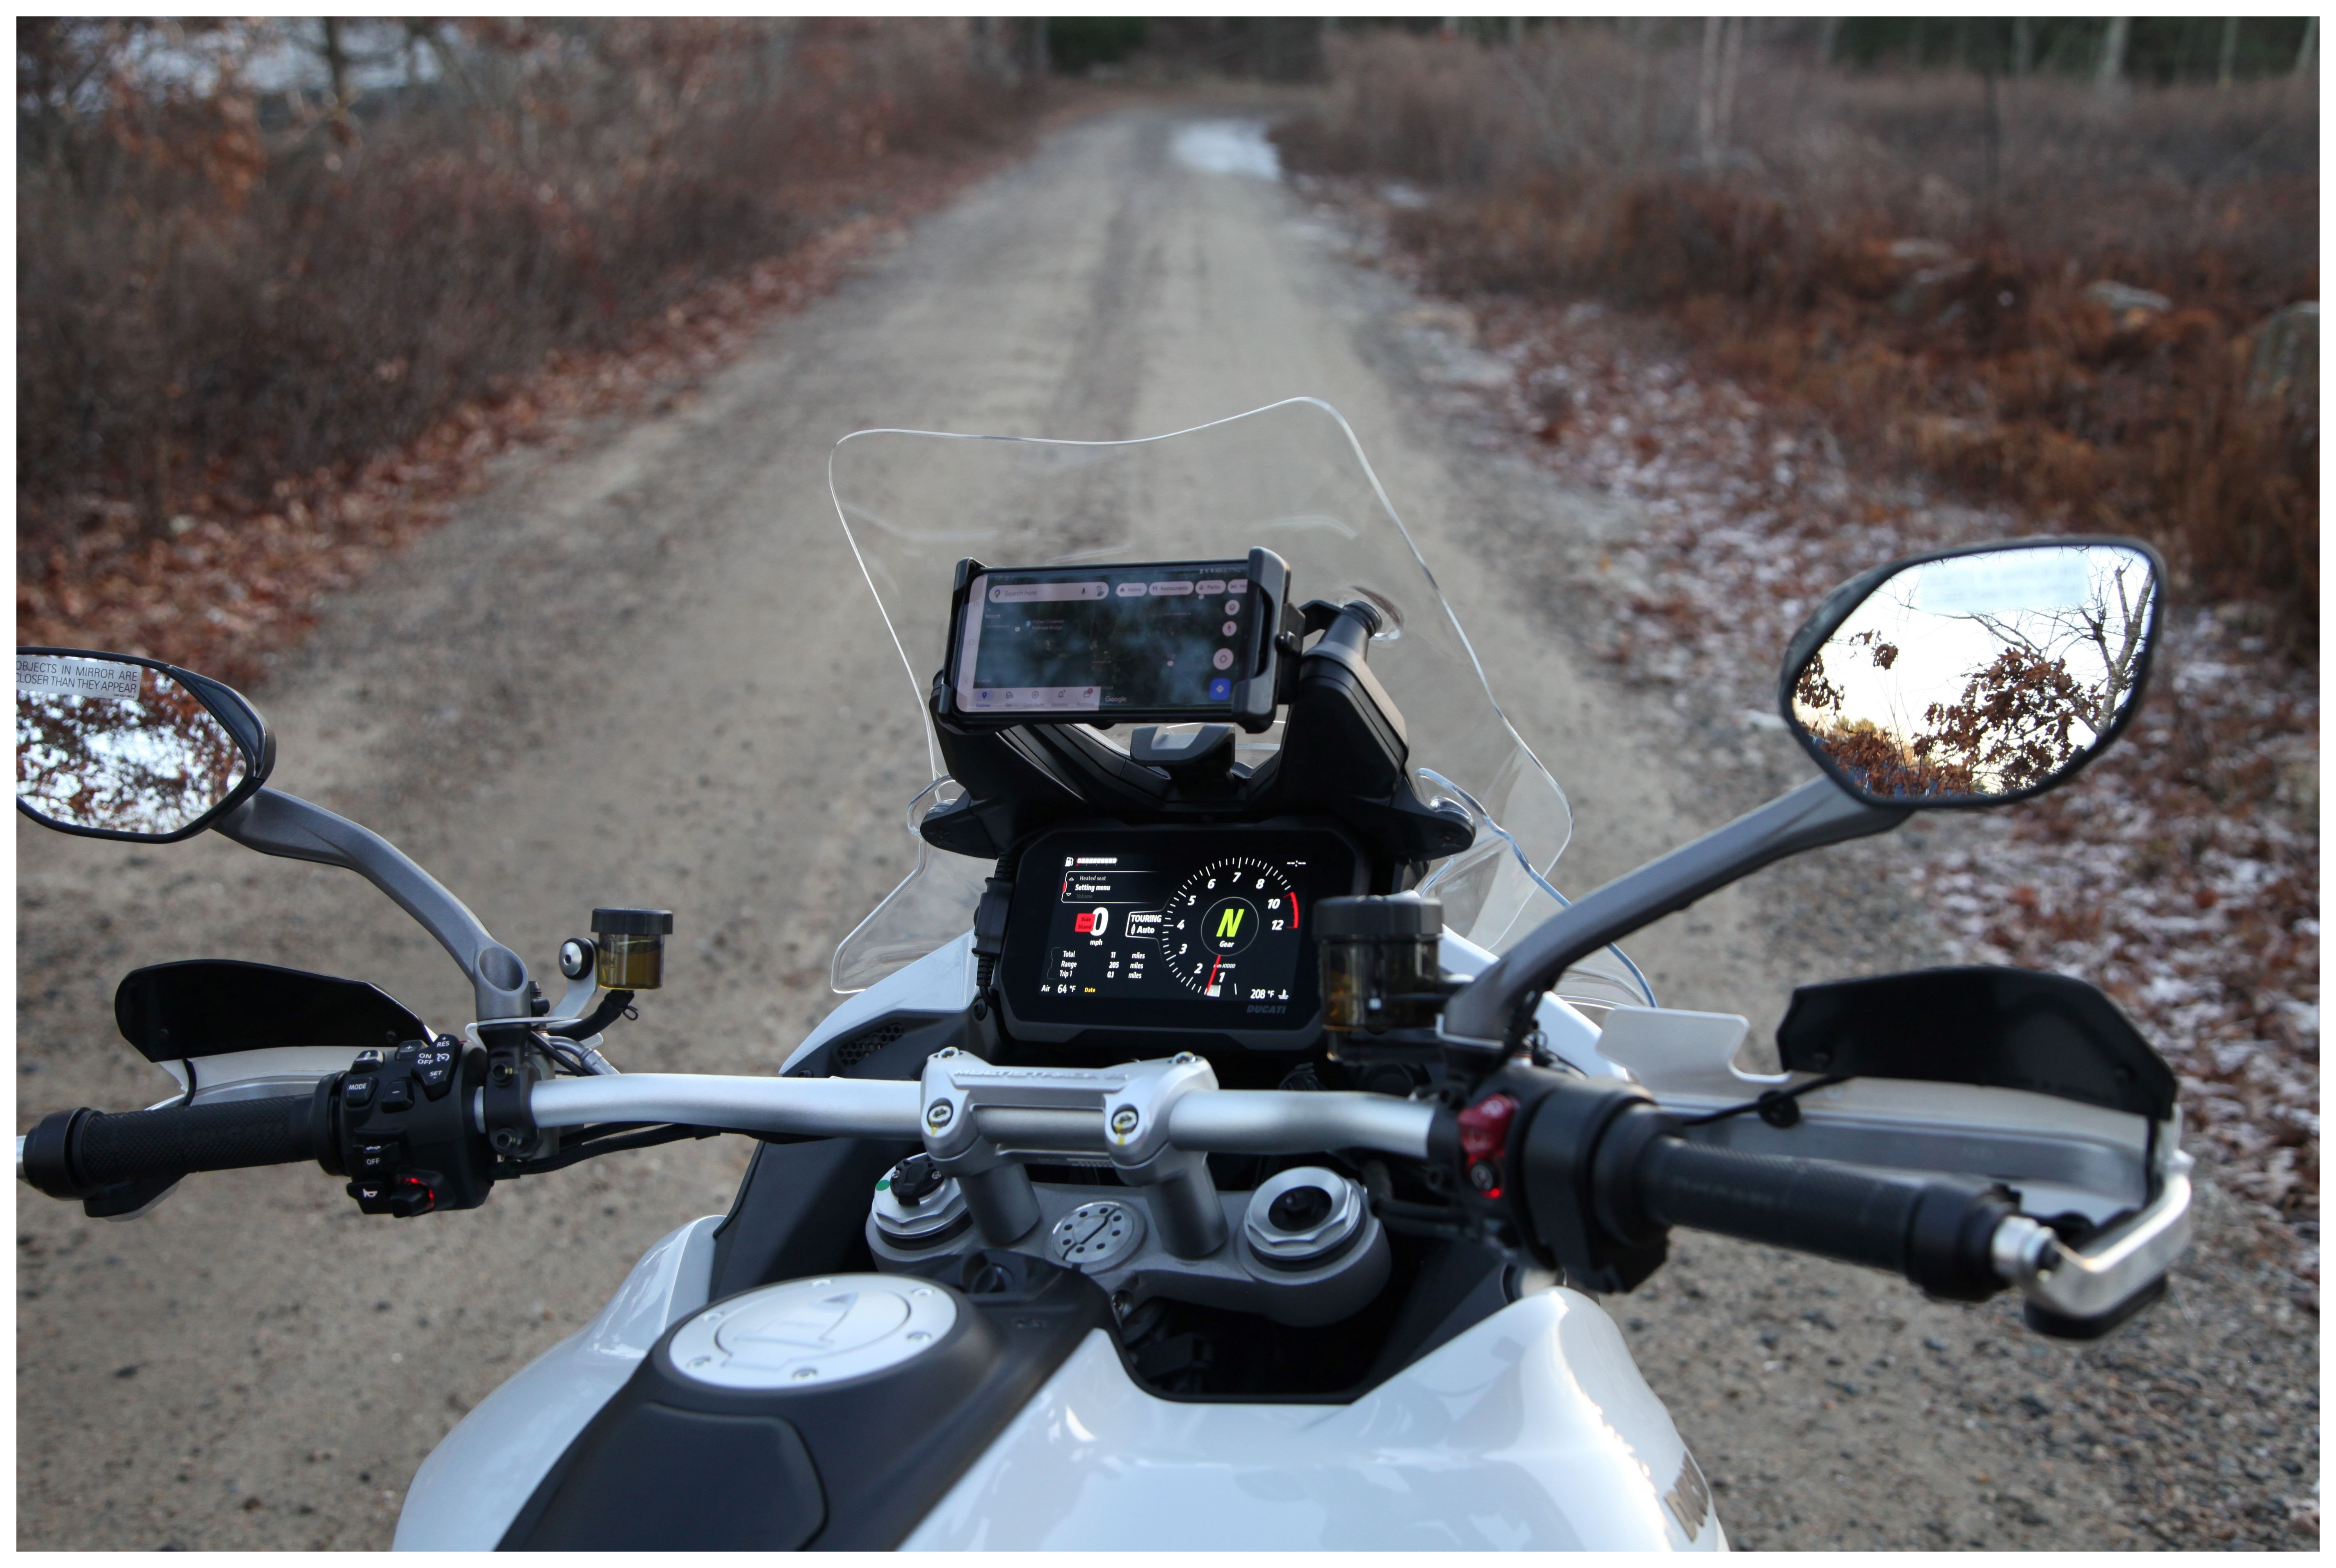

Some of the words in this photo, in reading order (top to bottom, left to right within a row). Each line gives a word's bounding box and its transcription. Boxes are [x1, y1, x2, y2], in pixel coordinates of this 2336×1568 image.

[16, 661, 57, 673] OBJECTS
[62, 665, 71, 675] IN
[76, 666, 114, 679] MIRROR
[119, 671, 138, 681] ARE
[16, 673, 48, 685] CLOSER
[51, 676, 75, 688] THAN
[77, 679, 100, 690] THEY
[101, 681, 136, 693] APPEAR
[1232, 872, 1241, 882] 7
[1207, 879, 1216, 889] 6
[1256, 879, 1265, 889] 8
[1187, 895, 1196, 905] 5
[1268, 898, 1280, 909] 10
[1089, 907, 1109, 936] 0
[1131, 914, 1162, 923] TOURING
[1216, 909, 1245, 937] N
[1136, 925, 1155, 934] Auto
[1177, 920, 1185, 930] 4
[1272, 920, 1284, 930] 12
[1179, 944, 1188, 954] 3
[1061, 960, 1077, 969] Range
[1194, 963, 1203, 973] 2
[1060, 970, 1069, 978] Trip
[1219, 972, 1225, 982] 1
[1057, 984, 1067, 994] 64
[1250, 989, 1266, 999] 208
[1246, 1005, 1287, 1014] DUCATI
